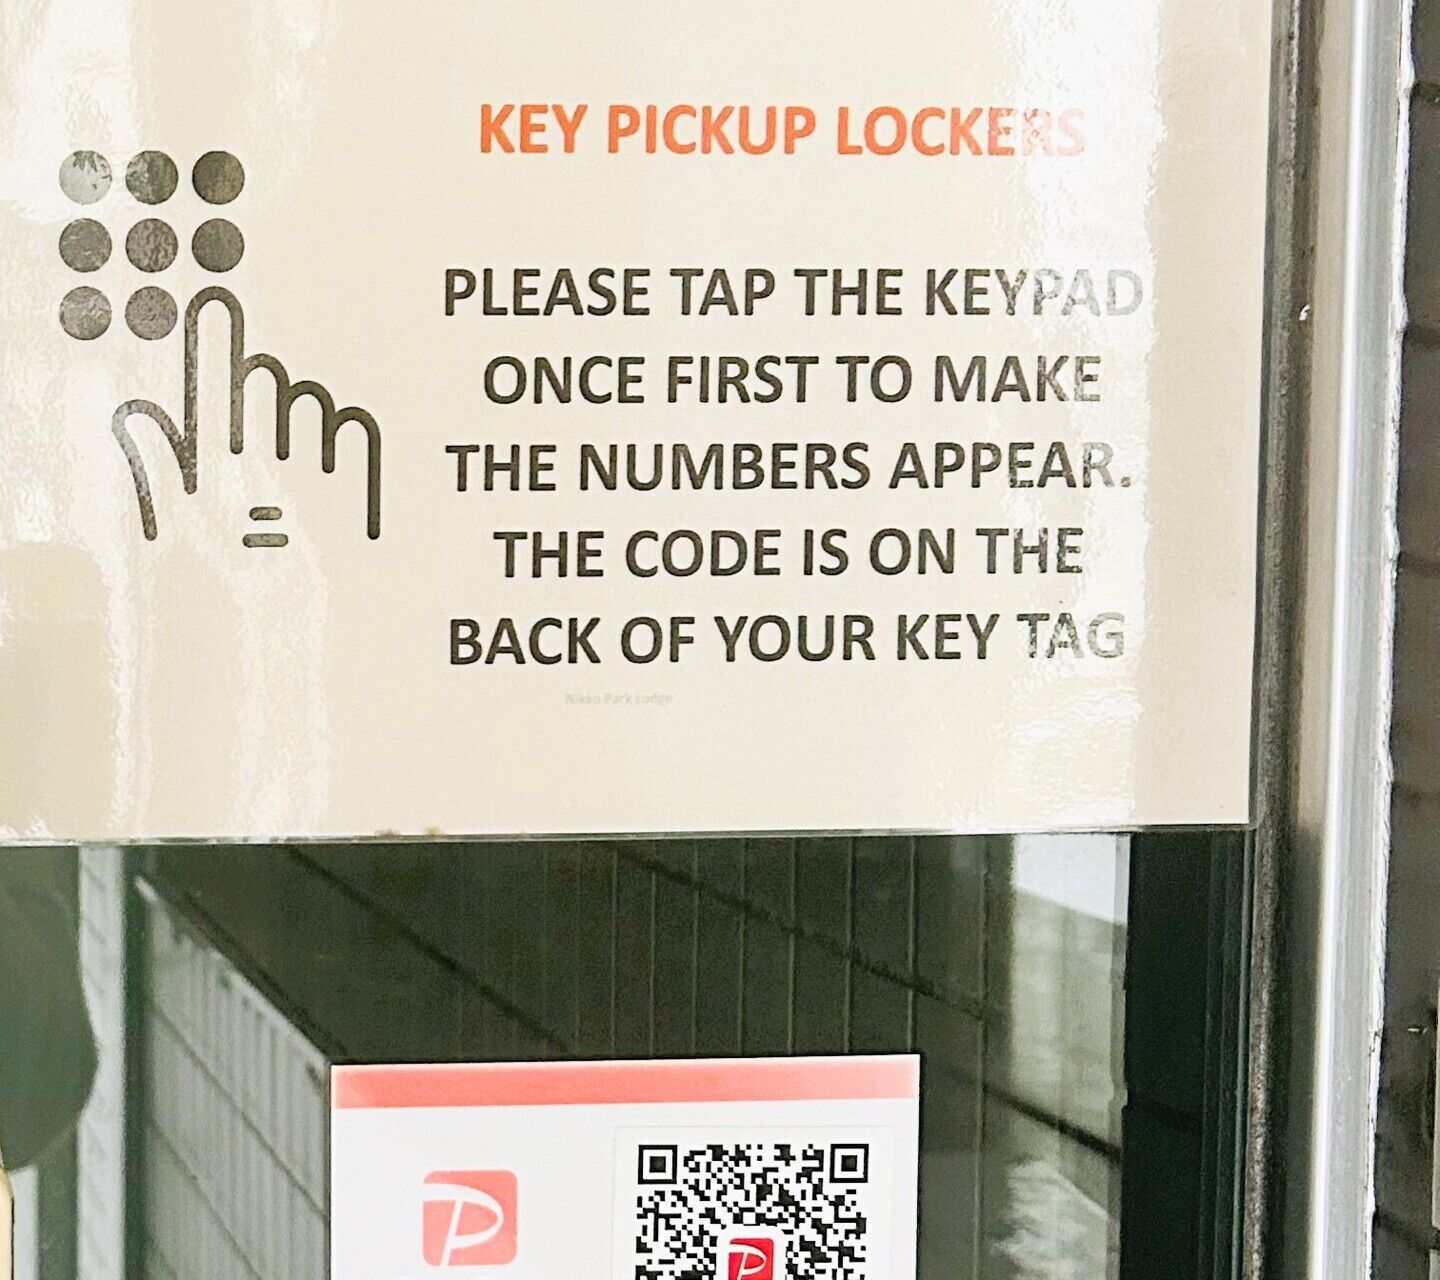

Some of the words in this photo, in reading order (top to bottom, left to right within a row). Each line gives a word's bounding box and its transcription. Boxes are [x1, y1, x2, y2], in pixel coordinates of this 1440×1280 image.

[480, 104, 588, 154] KEY
[608, 104, 816, 155] PICKUP
[835, 103, 1087, 156] LOCKERS
[445, 268, 650, 316] PLEASE
[670, 268, 775, 316] TAP
[794, 269, 903, 316] THE
[925, 268, 1144, 317] KEYPAD
[484, 356, 645, 404] ONCE
[668, 355, 819, 403] FIRST
[835, 355, 912, 403] TO
[934, 355, 1101, 402] MAKE
[445, 444, 556, 492] THE
[580, 442, 870, 491] NUMBERS
[888, 442, 1130, 489] APPEAR.
[493, 531, 604, 578] THE
[626, 529, 781, 578] CODE
[804, 529, 848, 576] IS
[869, 528, 955, 575] ON
[976, 528, 1083, 574] THE
[450, 617, 601, 665] BACK
[621, 617, 695, 664] OF
[714, 615, 876, 662] YOUR
[897, 614, 1000, 660] KEY
[1016, 613, 1124, 658] TAG
